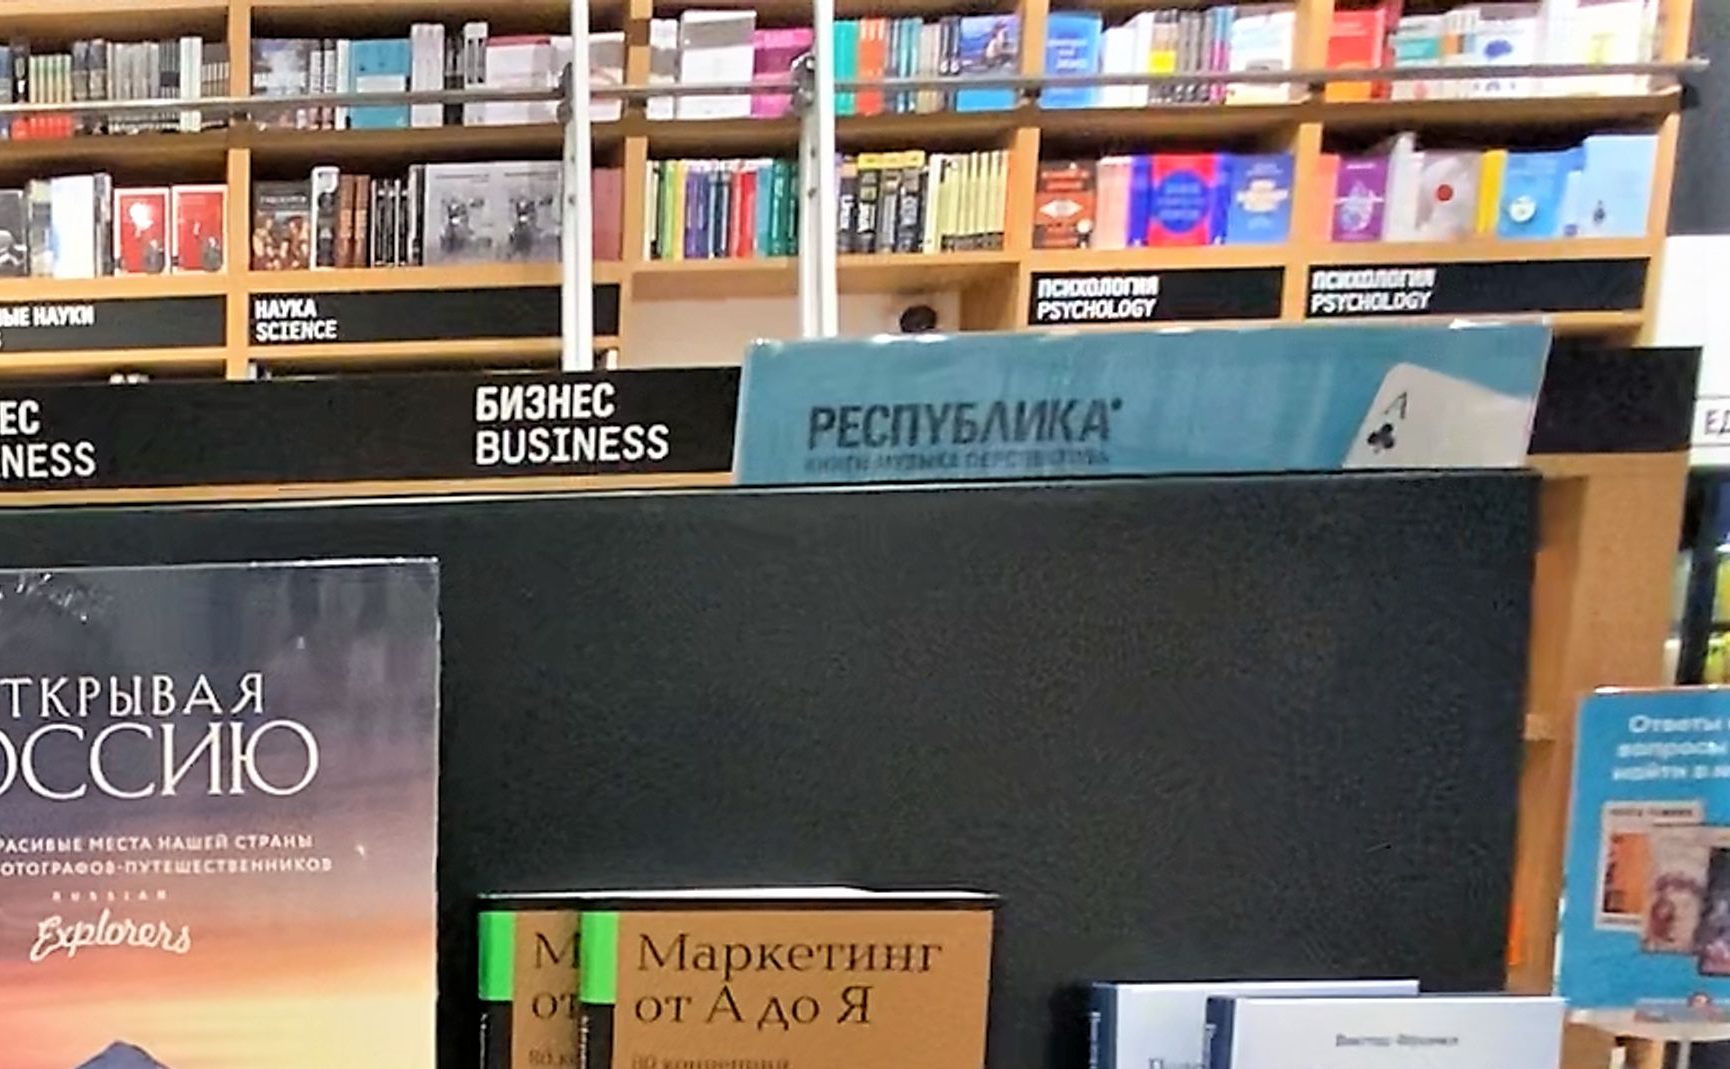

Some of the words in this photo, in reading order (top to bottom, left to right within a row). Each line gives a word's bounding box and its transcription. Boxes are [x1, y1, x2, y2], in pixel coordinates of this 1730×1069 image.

[1037, 276, 1159, 298] ПСИХОЛОГИЯ
[1311, 268, 1437, 290] ПСИХОЛОГИЯ
[255, 299, 317, 320] НАУКА
[1036, 299, 1156, 320] PSYCHOLOGY
[1310, 290, 1432, 313] PSYCHOLOGY
[33, 305, 95, 328] НАУКИ
[256, 320, 338, 342] SCIENCE
[475, 381, 615, 422] БИЗНЕС
[807, 398, 1112, 451] РЕСПУБЛИКА
[475, 424, 670, 467] BUSINESS
[89, 836, 152, 852] МЕСТА
[157, 833, 229, 850] НАШЕЙ
[234, 834, 313, 850] СТРАНЫ
[29, 907, 191, 962] Explorers
[636, 932, 943, 981] Маркетинг
[634, 995, 693, 1024] от
[705, 985, 743, 1024] А
[756, 996, 821, 1032] до
[836, 985, 875, 1025] Я
